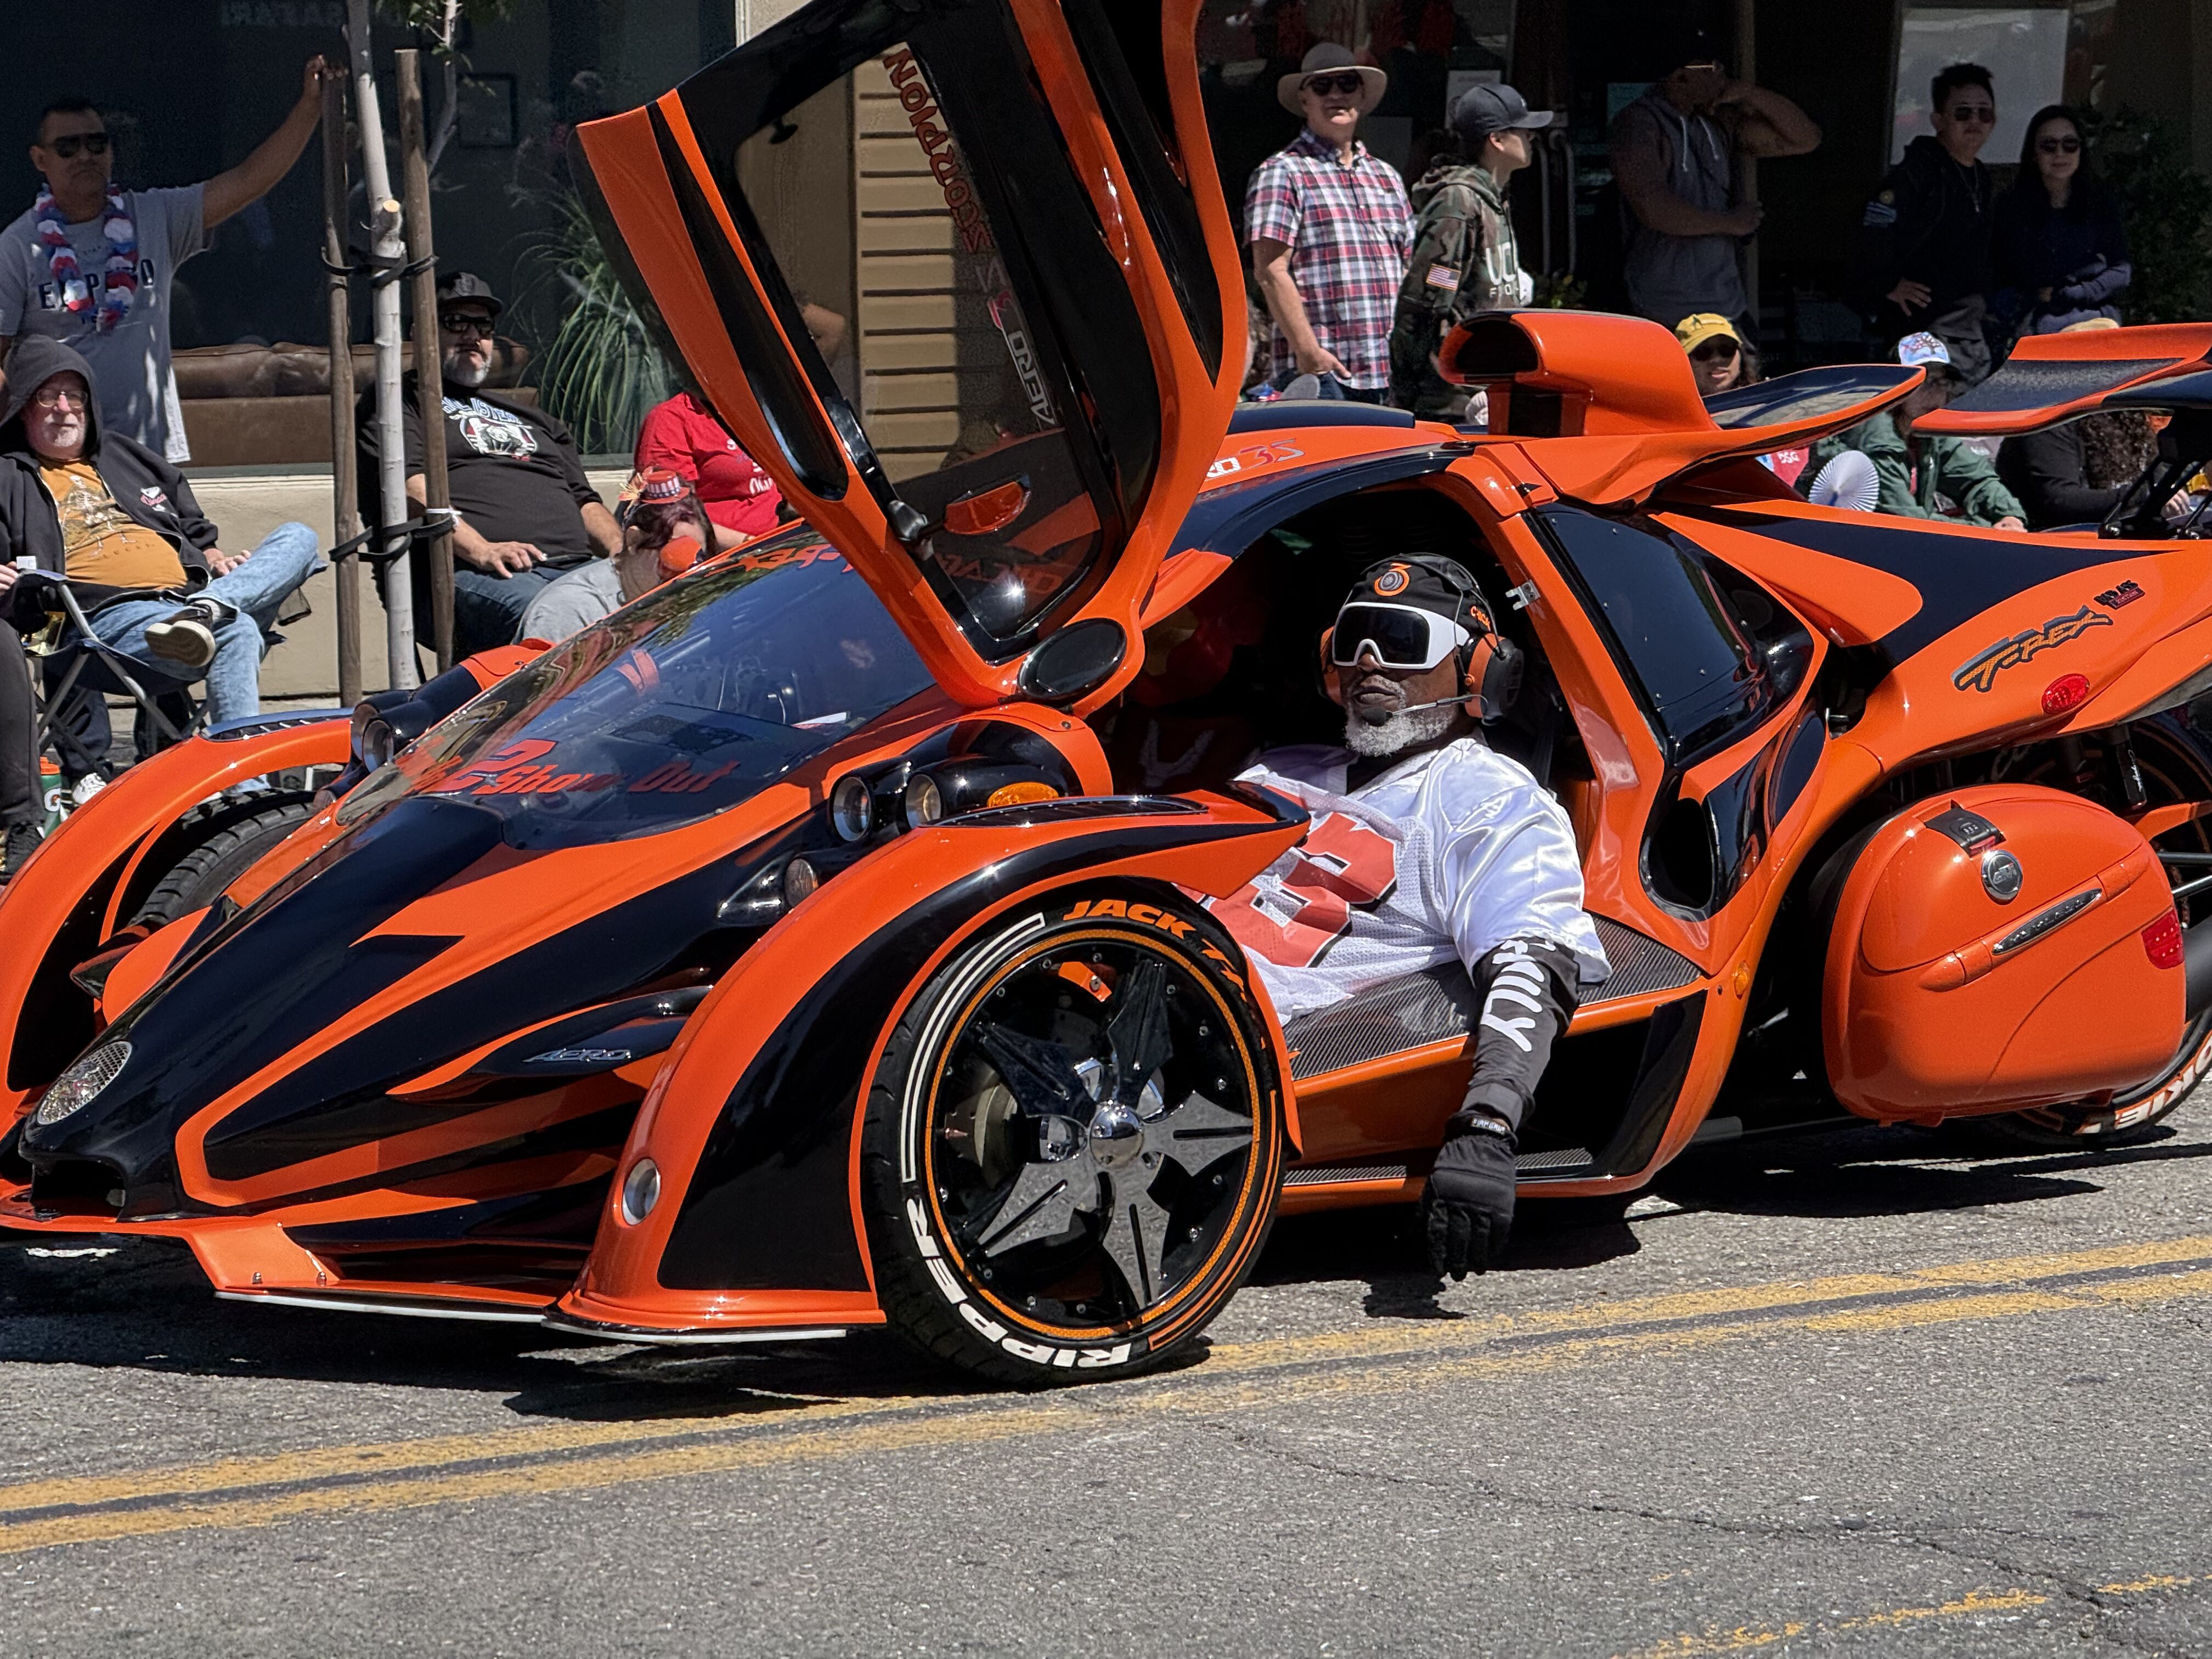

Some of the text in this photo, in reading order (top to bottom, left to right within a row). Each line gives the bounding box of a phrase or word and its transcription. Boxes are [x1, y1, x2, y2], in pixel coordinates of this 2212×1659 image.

[627, 760, 741, 793] Out
[1063, 899, 1197, 940] JACK
[522, 1047, 631, 1063] AERO
[906, 1197, 1132, 1368] RIPPER
